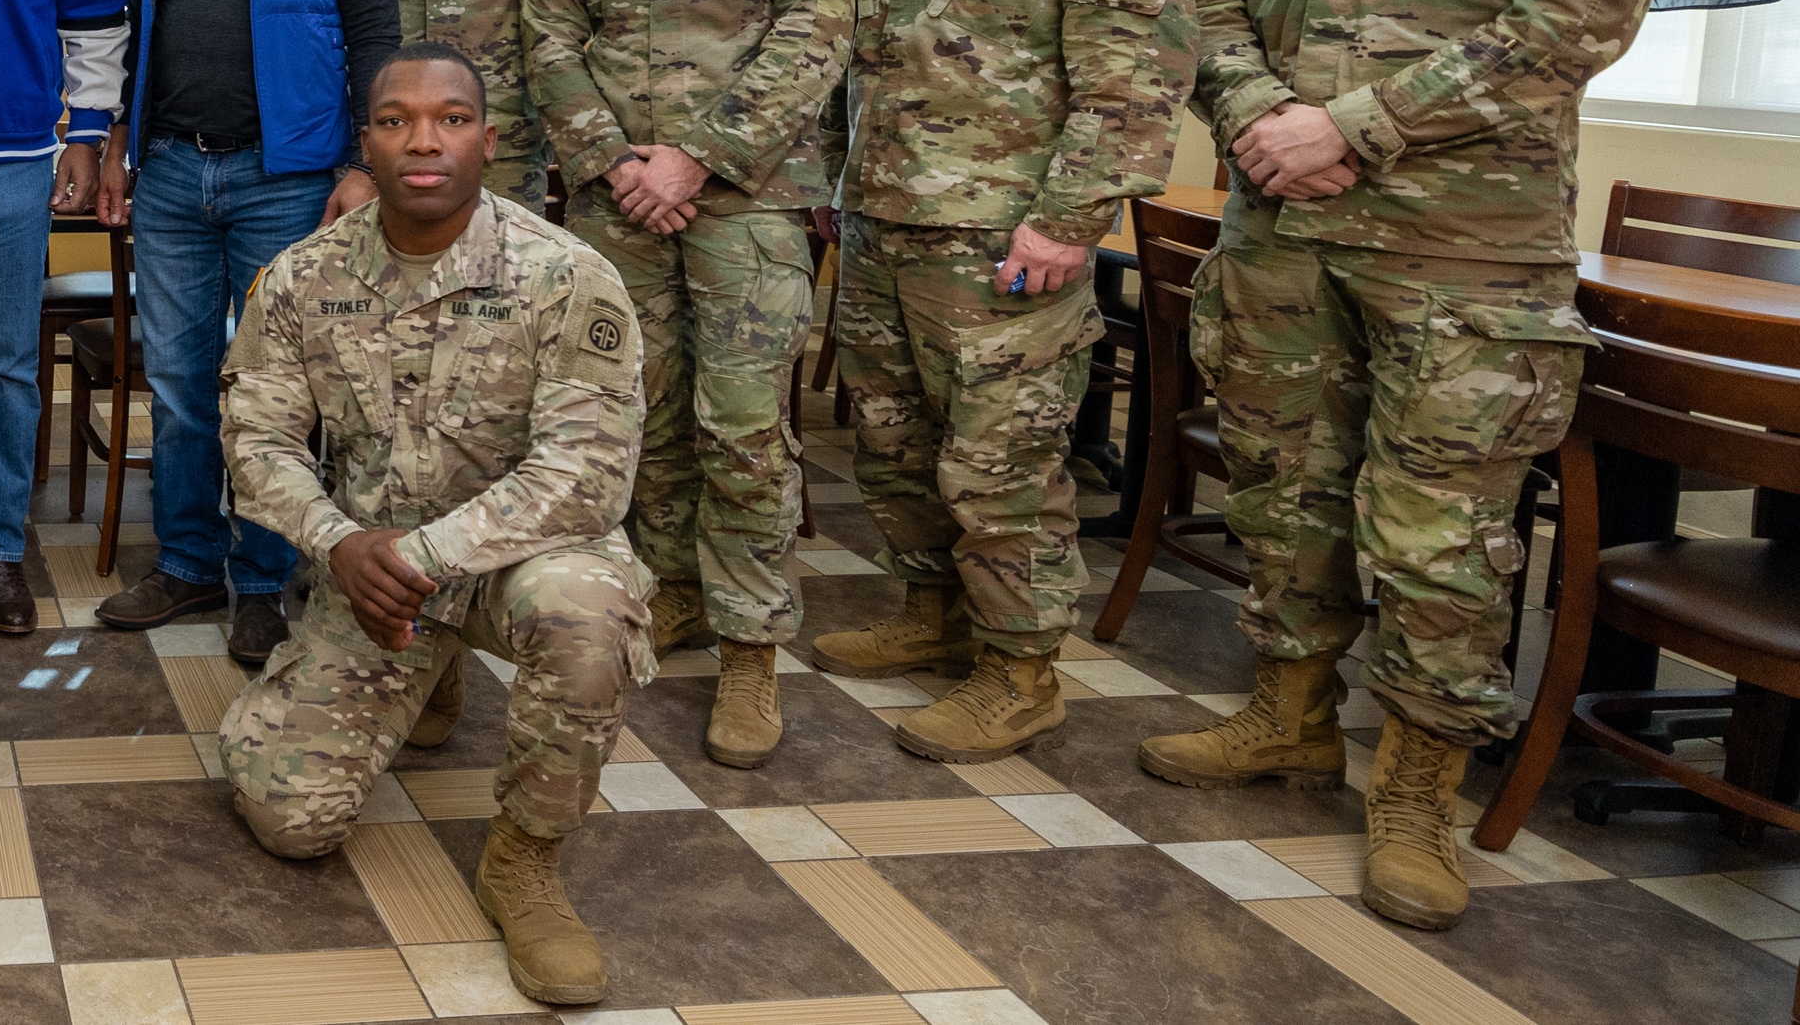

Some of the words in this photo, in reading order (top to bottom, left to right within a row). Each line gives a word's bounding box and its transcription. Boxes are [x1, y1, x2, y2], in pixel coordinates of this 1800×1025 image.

[320, 299, 372, 315] STANLEY
[452, 302, 473, 316] U.S.
[477, 304, 512, 320] ARMY
